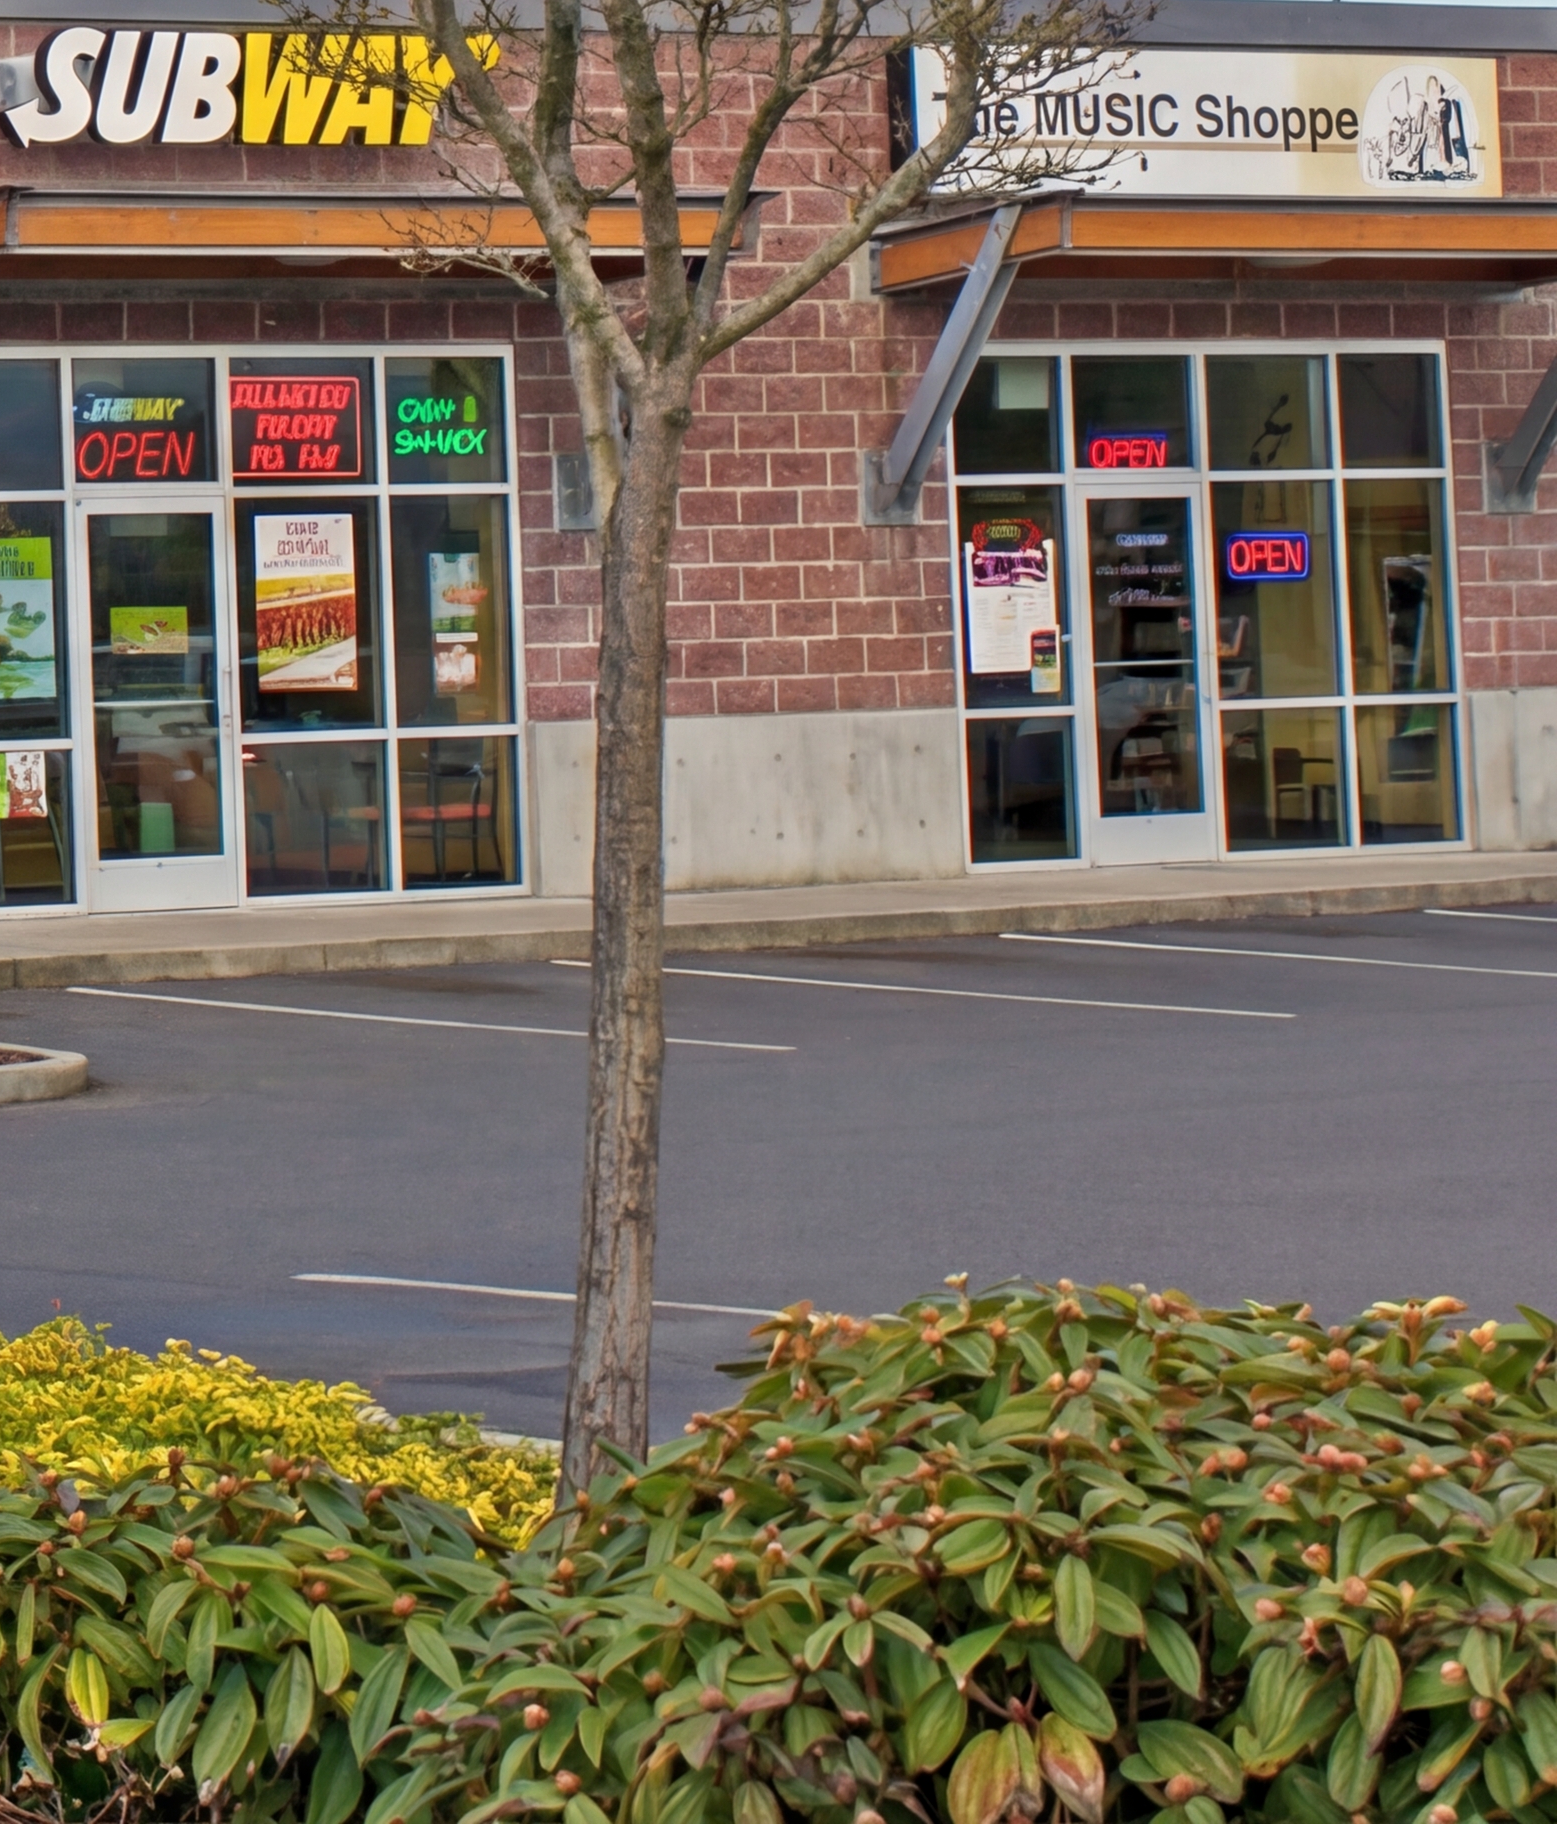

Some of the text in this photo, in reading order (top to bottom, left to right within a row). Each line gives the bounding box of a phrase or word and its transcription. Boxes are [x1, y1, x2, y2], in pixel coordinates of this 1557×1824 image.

[5, 26, 500, 148] SUBWAY
[1035, 92, 1180, 138] MUSIC
[1195, 93, 1360, 153] Shoppe
[77, 430, 196, 479] OPEN
[1089, 438, 1169, 468] OPEN
[1229, 539, 1303, 573] OPEN
